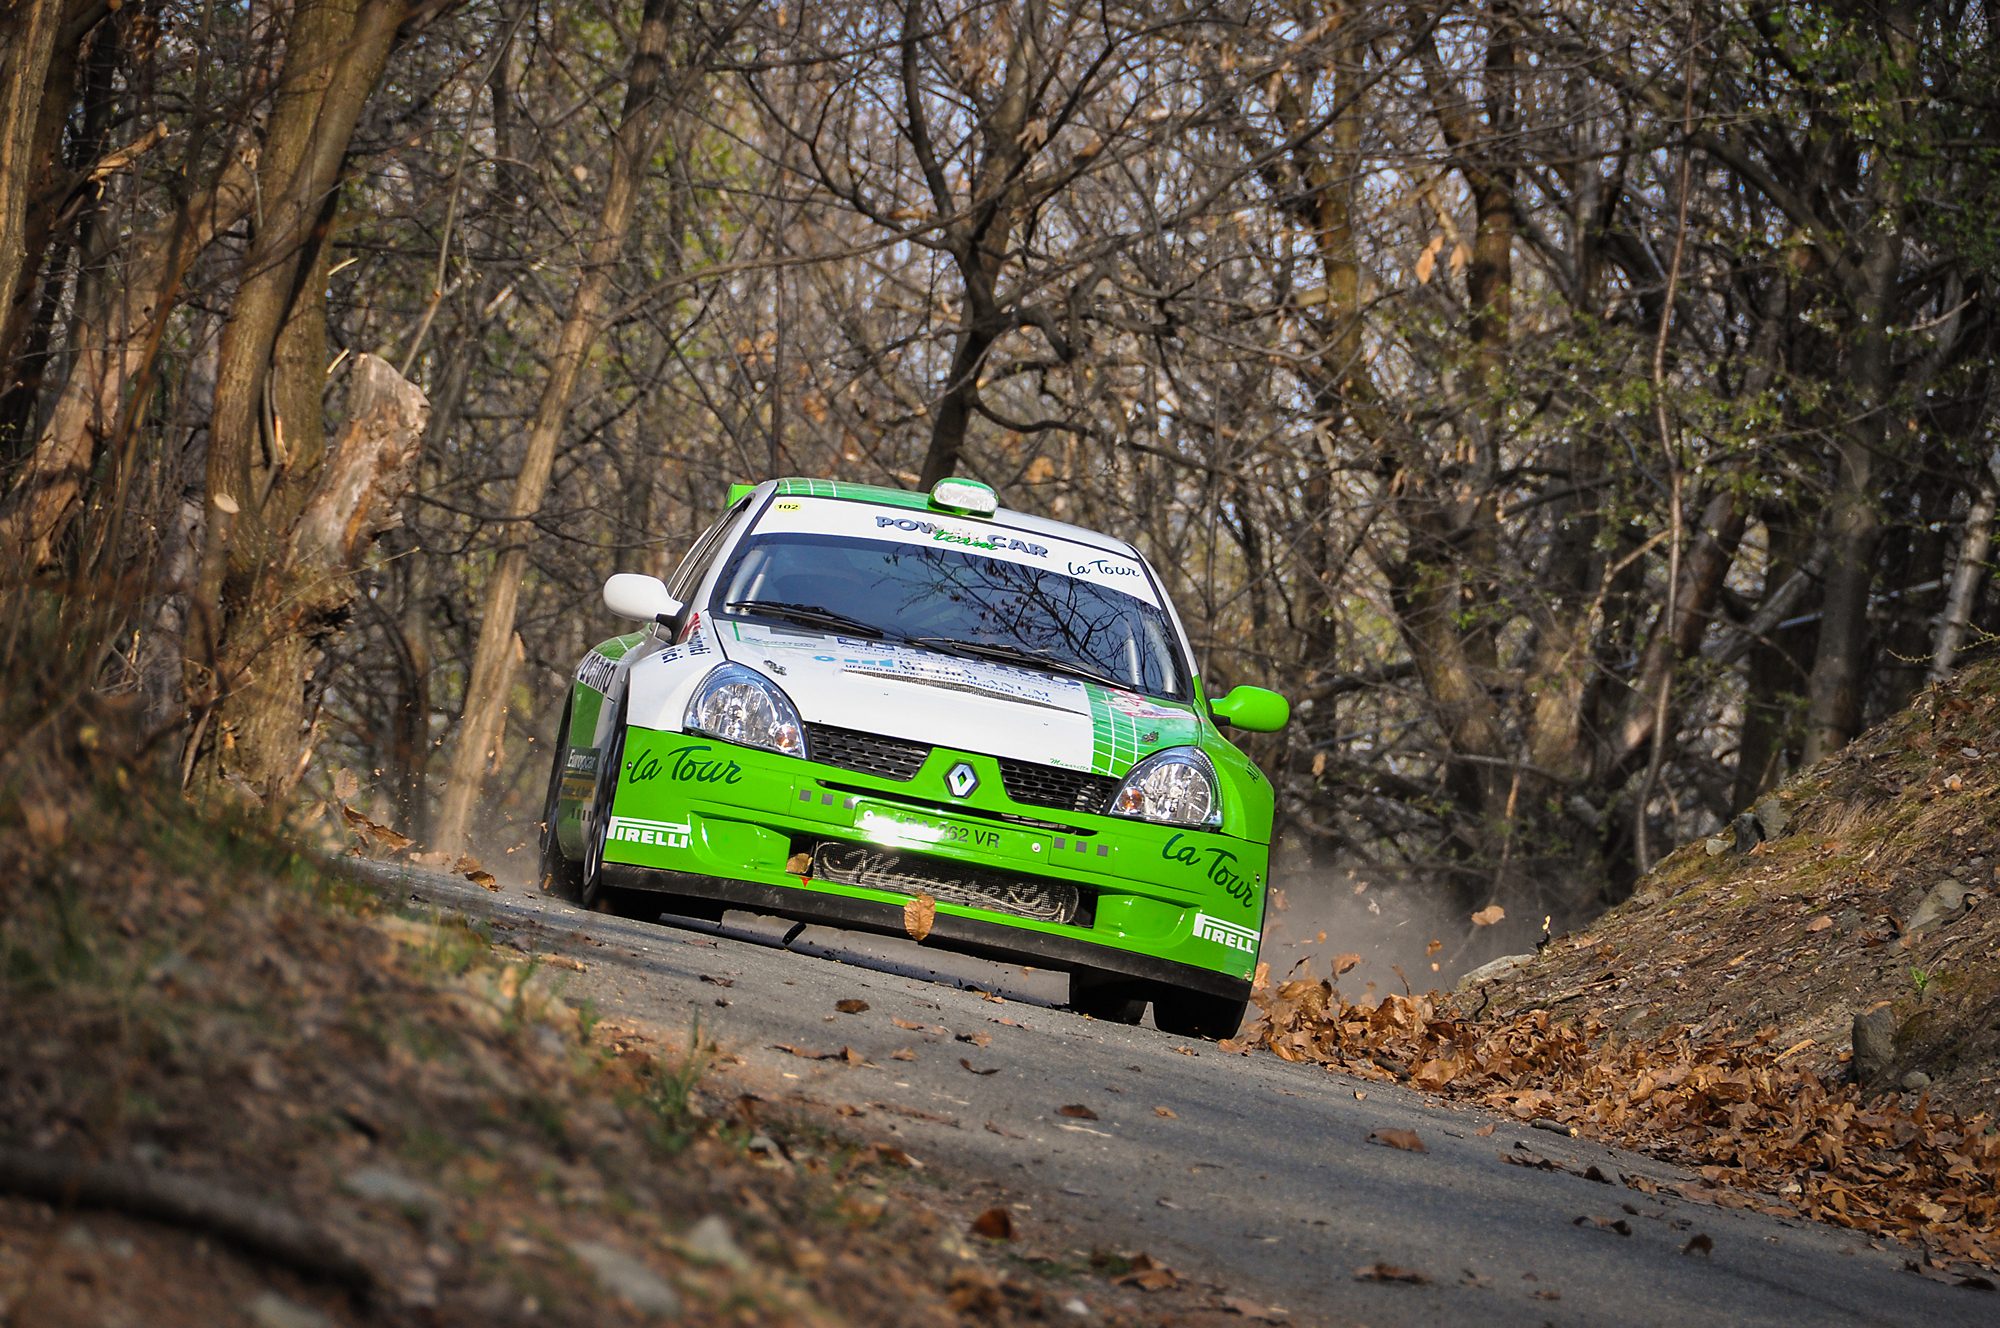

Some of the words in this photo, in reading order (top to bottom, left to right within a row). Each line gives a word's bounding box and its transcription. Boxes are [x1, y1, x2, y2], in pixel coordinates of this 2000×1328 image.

[875, 515, 1048, 558] POWCAR
[933, 530, 998, 551] team
[1088, 559, 1140, 577] Tour
[845, 664, 883, 672] UFFICIO
[903, 670, 960, 682] PROOTORI
[668, 745, 743, 785] Tour
[606, 815, 692, 849] PIRELLI
[974, 829, 1001, 848] VR
[1205, 847, 1253, 908] Tour
